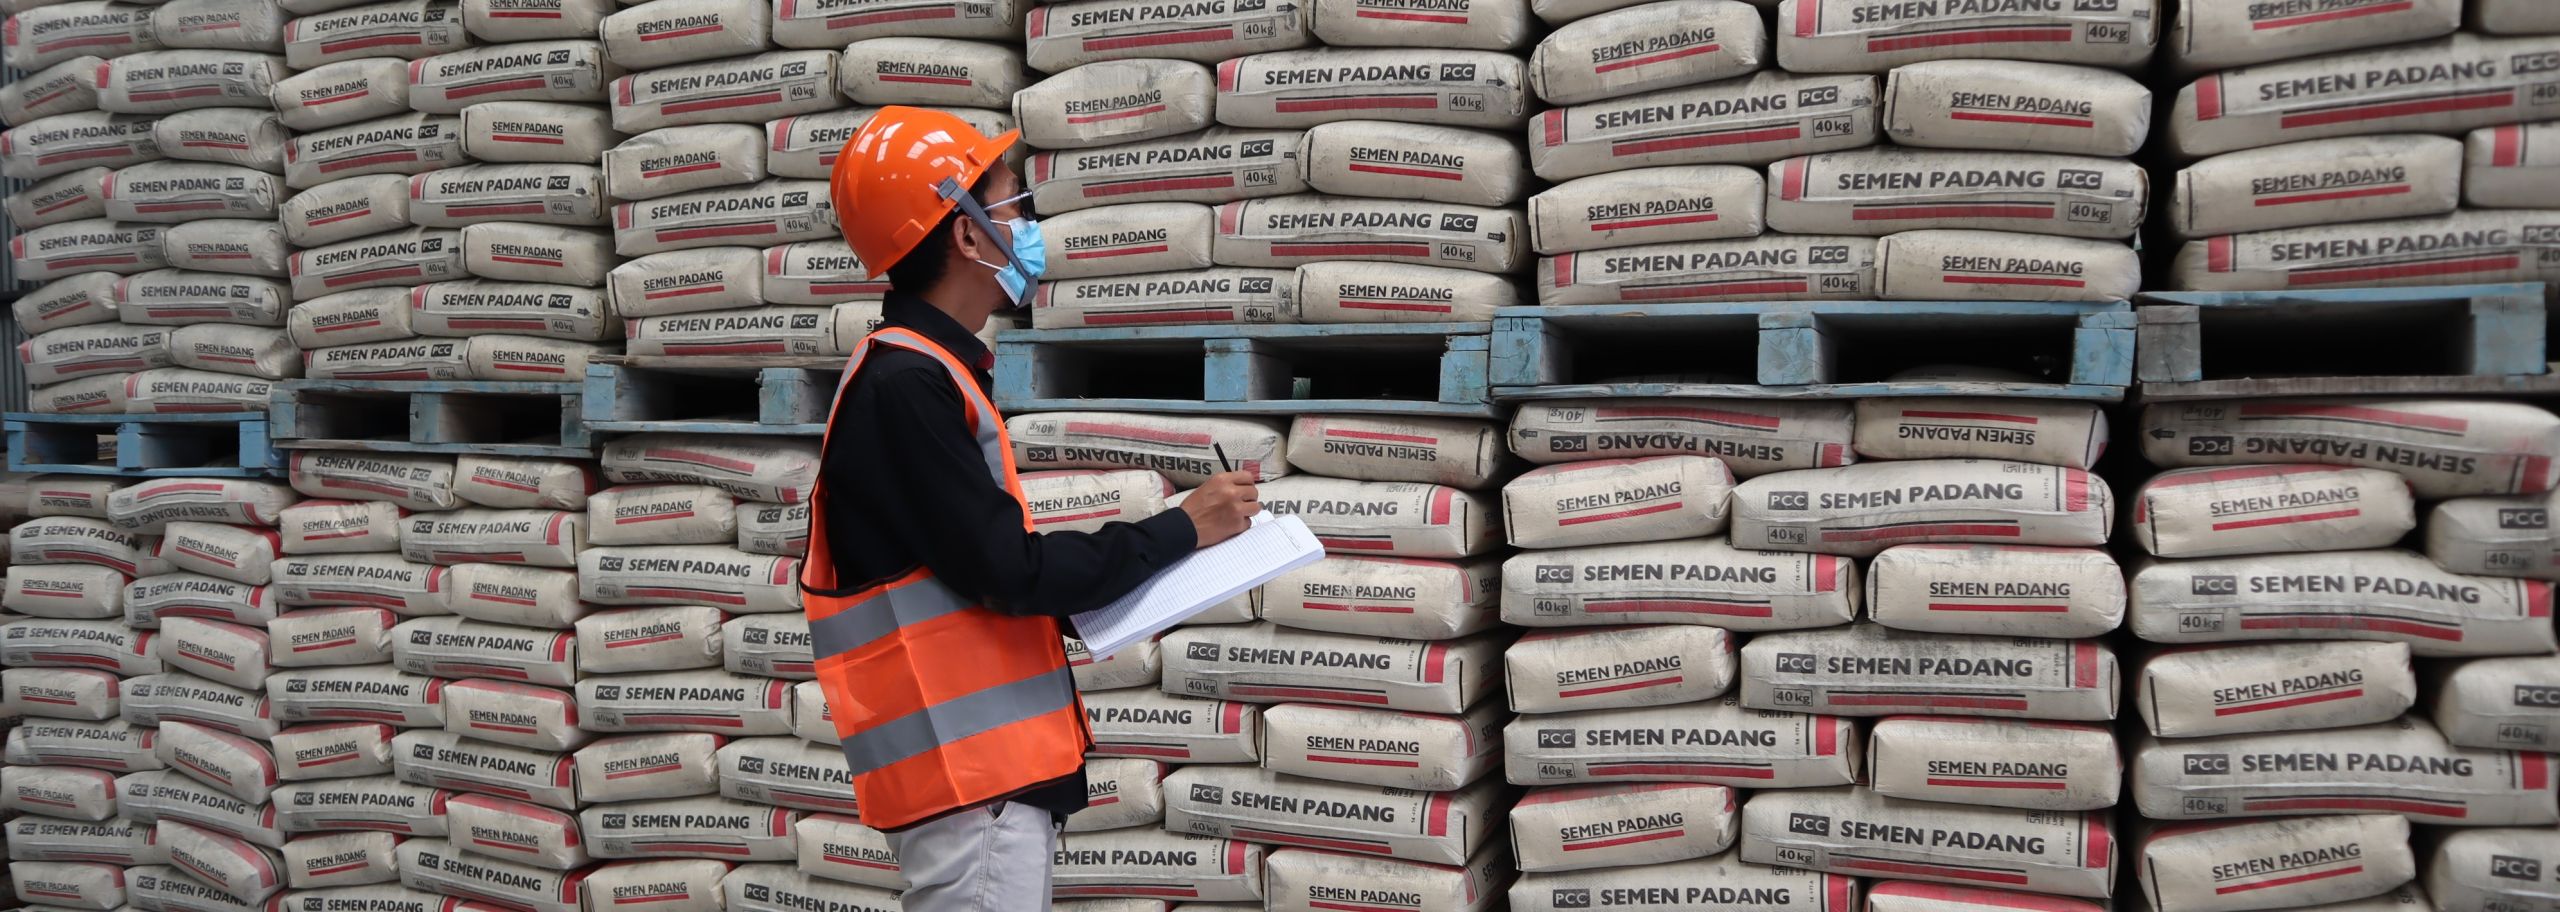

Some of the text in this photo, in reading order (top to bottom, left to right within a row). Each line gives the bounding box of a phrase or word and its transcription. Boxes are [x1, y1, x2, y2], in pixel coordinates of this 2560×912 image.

[1071, 1, 1225, 26] SEMEN PADANG
[1852, 1, 1937, 23] SEMEN
[315, 13, 418, 32] SEMEN PADANG
[637, 13, 719, 34] SEMEN PADANG
[127, 64, 217, 81] SEMEN PADANG
[440, 51, 568, 76] SEMEN PADANG PCC
[1265, 65, 1474, 85] SEMEN PADANG PCC
[2260, 61, 2495, 101] SEMEN PADANG
[1594, 88, 1835, 129] SEMEN PADANG PCC
[1952, 92, 2092, 114] SEMEN PADANG
[312, 126, 438, 153] SEMEN PADANG PCC
[1350, 147, 1464, 167] SEMEN PADANG
[441, 177, 569, 194] SEMEN PADANG PCC
[1839, 171, 2100, 190] SEMEN PADANG PCC
[2252, 167, 2405, 194] SEMEN PADANG
[651, 193, 807, 219] SEMEN PADANG PCC
[1589, 197, 1713, 221] SEMEN PADANG
[1268, 213, 1475, 230] SEMEN PADANG PCC
[1065, 229, 1167, 249] SEMEN PADANG
[2272, 230, 2508, 262] SEMEN PADANG
[315, 240, 441, 266] SEMEN PADANG PCC
[1943, 256, 2083, 274] SEMEN PADANG
[1340, 284, 1452, 300] SEMEN PADANG
[659, 314, 817, 333] SEMEN PADANG PCC
[47, 336, 138, 355] SEMEN PADANG
[327, 345, 425, 361] SEMEN PADANG
[152, 383, 241, 394] SEMEN PADANG
[1900, 426, 2034, 444] SEMEN PADANG
[1066, 450, 1212, 475] SEMEN PADANG
[1028, 490, 1120, 511] EMEN PADANG
[1557, 482, 1681, 512] SEMEN PADANG
[1769, 484, 2022, 509] PCC SEMEN PADANG
[2211, 487, 2360, 515] SEMEN PADANG
[1307, 500, 1398, 516] PADANG
[437, 521, 530, 534] SEMEN PADANG
[2501, 511, 2546, 526] PCC
[600, 558, 750, 578] PCC SEMEN PADANG
[1537, 564, 1775, 584] PCC SEMEN PADANG
[1304, 584, 1416, 598] SEMEN PADANG
[1930, 582, 2070, 596] SEMEN PADANG
[2194, 576, 2480, 603] PCC SEMEN PADANG
[30, 628, 123, 645] SEMEN PADANG
[436, 633, 533, 652] SEMEN PADANG
[1188, 644, 1219, 659] PCC
[1228, 647, 1295, 664] SEMEN
[1301, 651, 1390, 669] PADANG
[1778, 656, 1814, 671] PCC
[1828, 656, 1911, 675] SEMEN
[1919, 658, 2032, 676] PADANG
[1557, 656, 1681, 684] SEMEN PADANG
[311, 681, 408, 695] SEMEN PADANG
[596, 686, 744, 701] PCC SEMEN PADANG
[2214, 670, 2363, 703] SEMEN PADANG
[1107, 709, 1191, 724] PADANG
[1307, 736, 1419, 753] SEMEN PADANG
[1540, 731, 1573, 745] PCC
[1586, 730, 1666, 746] SEMEN
[1672, 729, 1775, 747] PADANG
[1928, 761, 2067, 776] SEMEN PADANG
[2187, 754, 2473, 776] PCC SEMEN PADANG
[319, 793, 415, 807] SEMEN PADANG
[1192, 786, 1222, 801] PCC
[1232, 792, 1297, 811] SEMEN
[1302, 801, 1394, 822] PADANG
[632, 815, 749, 829] SEMEN PADANG
[1561, 813, 1683, 840] SEMEN PADANG
[1791, 817, 2044, 854] PCC SEMEN PADANG
[1054, 851, 1197, 866] EMEN PADANG
[2212, 844, 2361, 879] SEMEN PADANG
[2493, 858, 2538, 877] PCC
[444, 860, 542, 891] SEMEN PADANG
